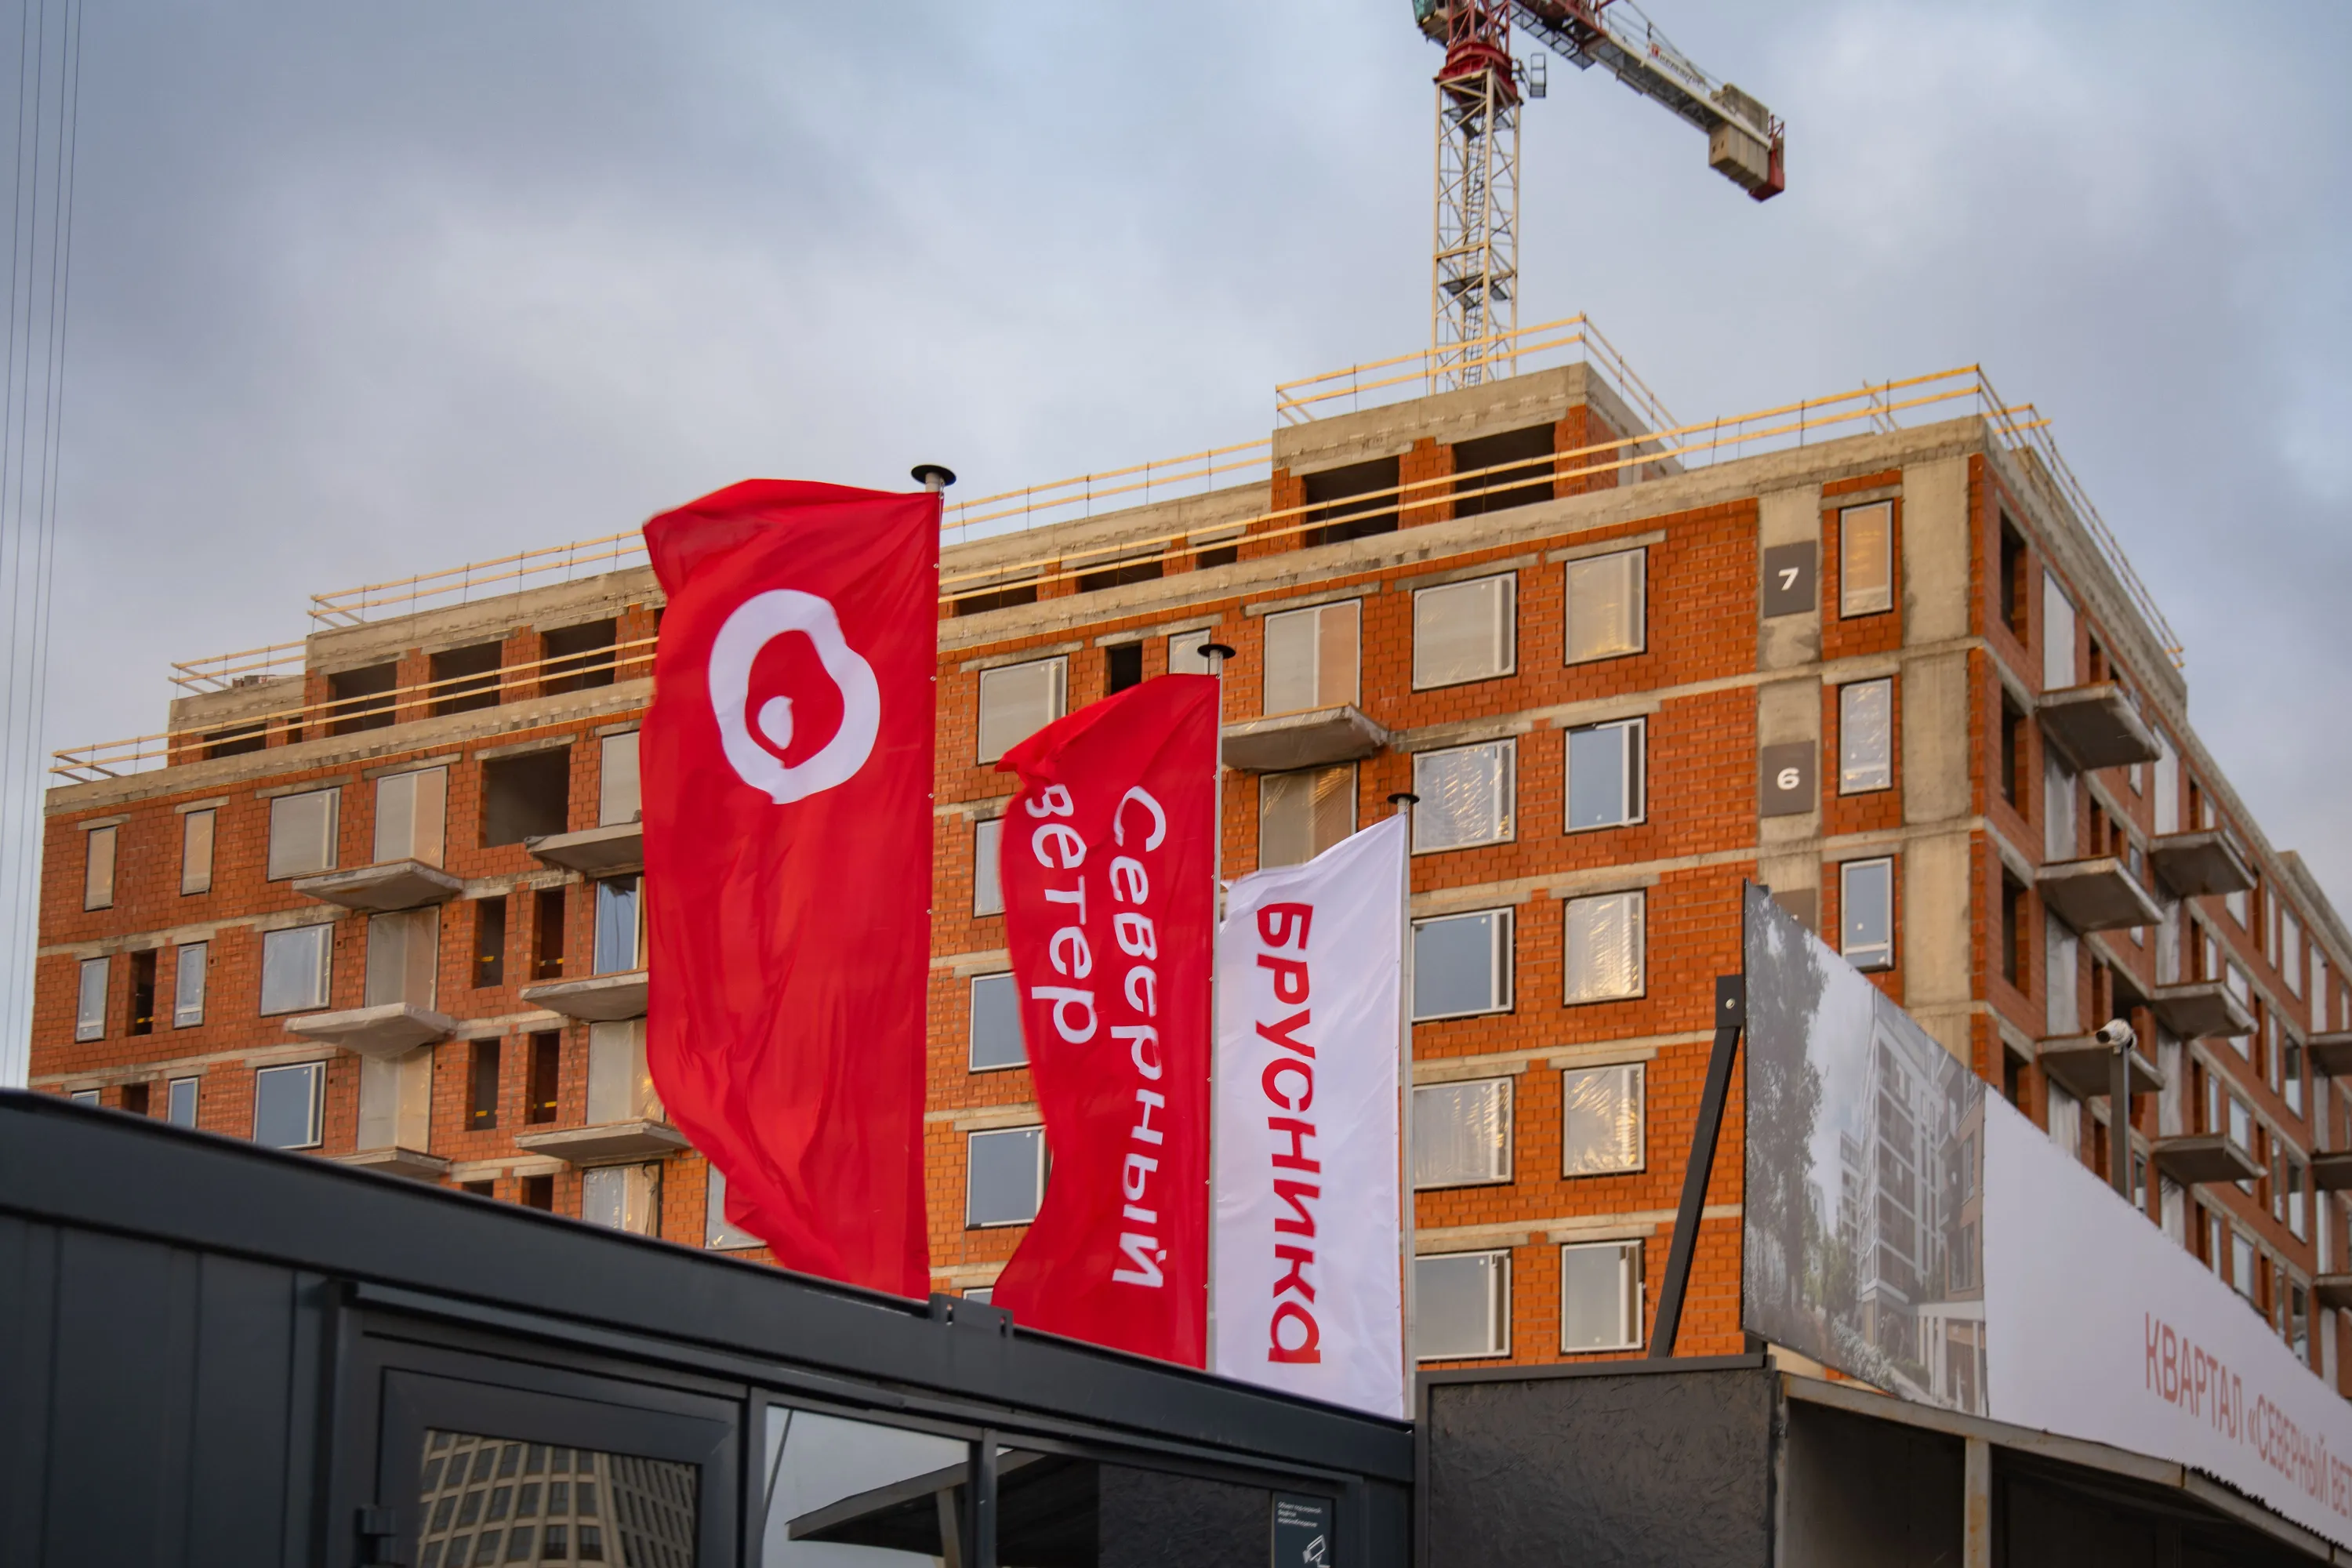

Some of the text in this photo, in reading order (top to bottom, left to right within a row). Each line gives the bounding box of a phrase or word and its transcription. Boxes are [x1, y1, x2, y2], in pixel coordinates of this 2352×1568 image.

[1778, 567, 1799, 591] 7
[1777, 768, 1800, 790] 6
[1025, 784, 1098, 1044] ветер
[1109, 785, 1167, 1288] Северный
[2144, 1312, 2243, 1446] КВАРТАЛ
[2247, 1393, 2328, 1507] «СЕВЕРНЫЙ
